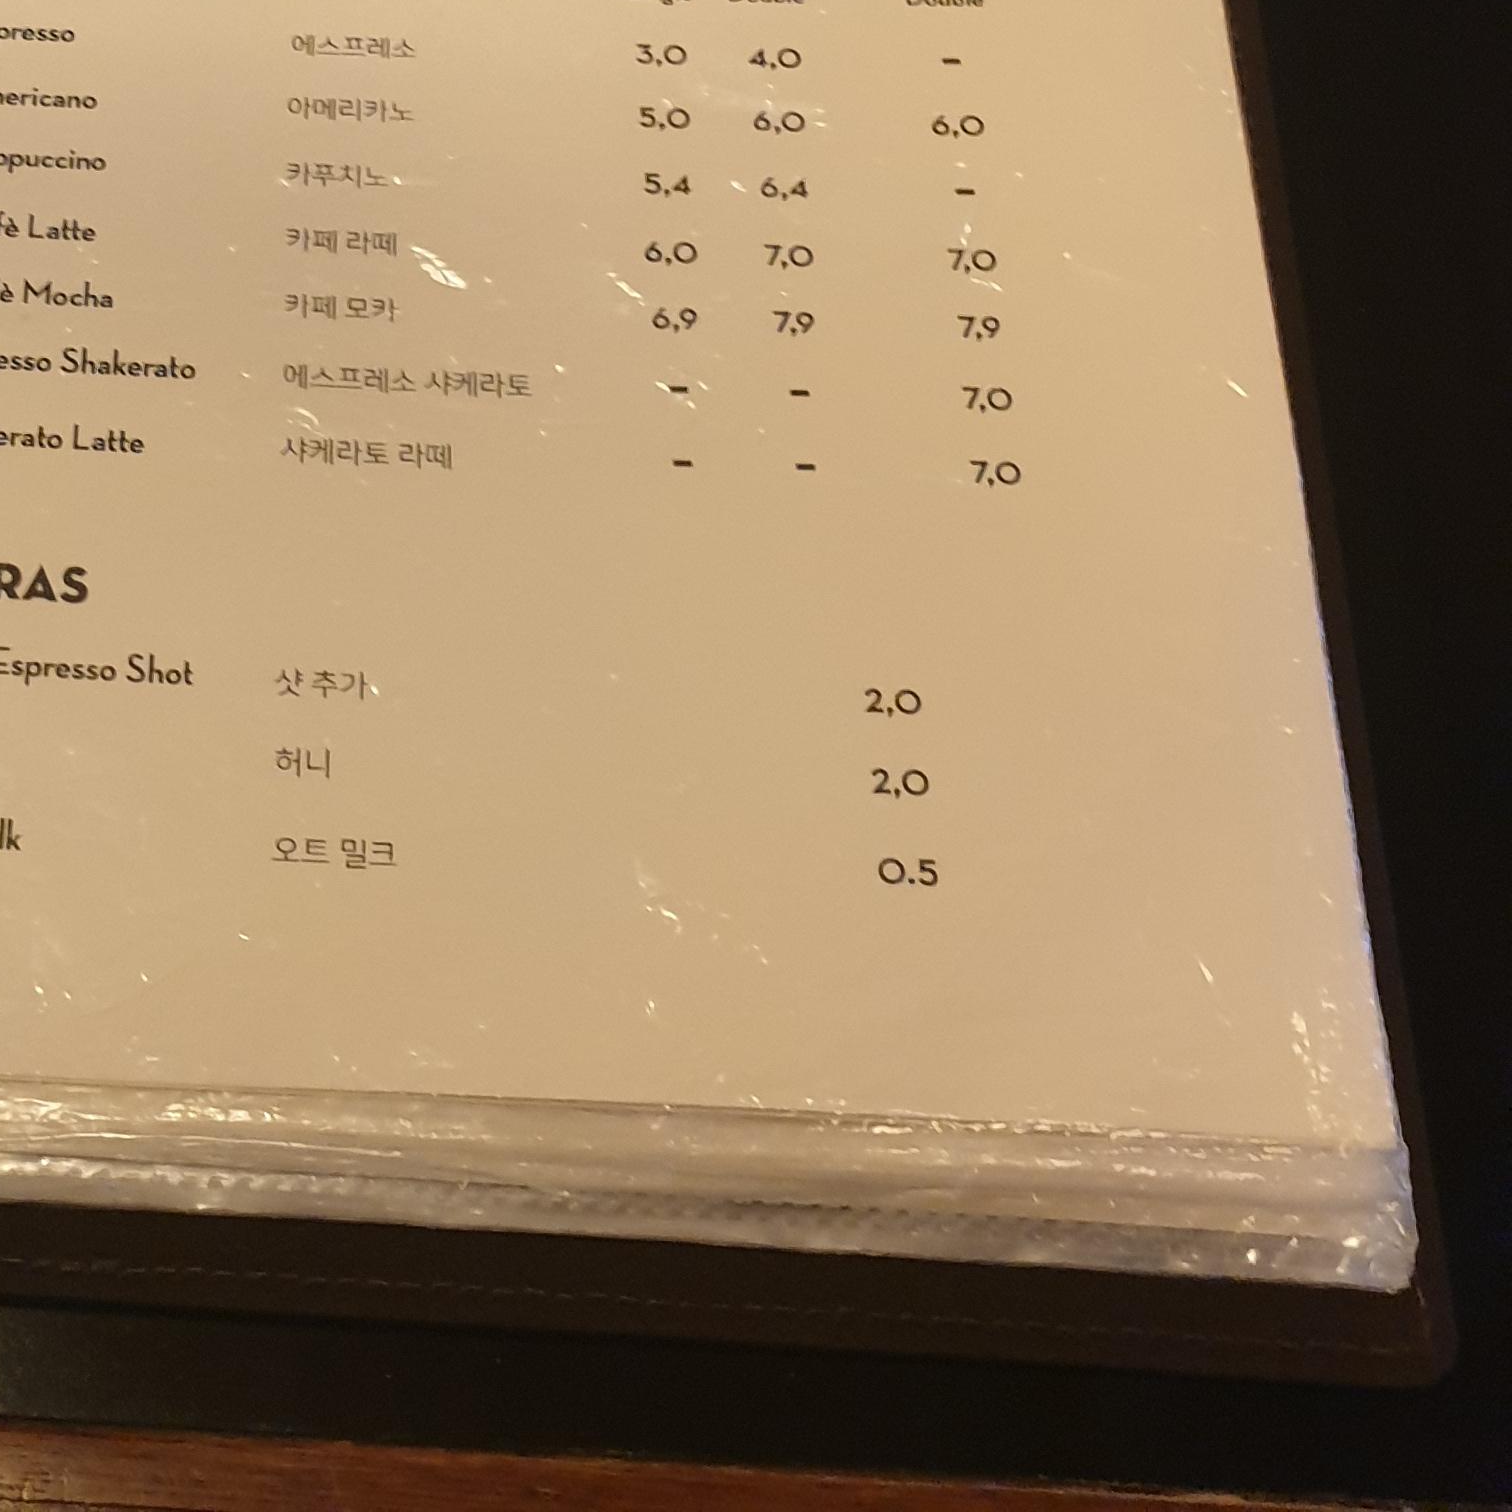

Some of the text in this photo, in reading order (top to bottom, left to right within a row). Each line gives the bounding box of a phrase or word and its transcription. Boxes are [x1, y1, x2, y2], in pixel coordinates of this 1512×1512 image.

[291, 35, 415, 58] 에스프레소
[636, 44, 801, 69] 3,0 4,0
[288, 97, 414, 122] 아메리카노
[640, 107, 984, 138] 5,0 6,0 6,0
[287, 163, 388, 188] 카푸치노
[644, 173, 808, 201] 5,4 6,4
[28, 214, 96, 241] Latte
[286, 228, 397, 256] 카페 라떼
[645, 242, 997, 274] 6,0 7,0 7,0
[23, 279, 113, 308] Mocha
[285, 294, 398, 322] 카페 모카
[652, 308, 1000, 340] 6,9 7,9 7,9
[60, 347, 195, 379] Shakerato
[283, 364, 532, 398] 에스프레소 샤케라토
[962, 386, 1012, 413] 7,0
[73, 424, 144, 453] Latte
[281, 437, 452, 470] 샤케라토 라떼
[970, 461, 1021, 486] 7,0
[126, 654, 192, 685] Shot
[275, 668, 368, 700] 샷 추가
[865, 688, 921, 717] 2,0
[276, 748, 330, 779] 허니
[872, 768, 929, 798] 2,0
[272, 838, 396, 869] 오트 밀크
[878, 858, 938, 886] 0.5
